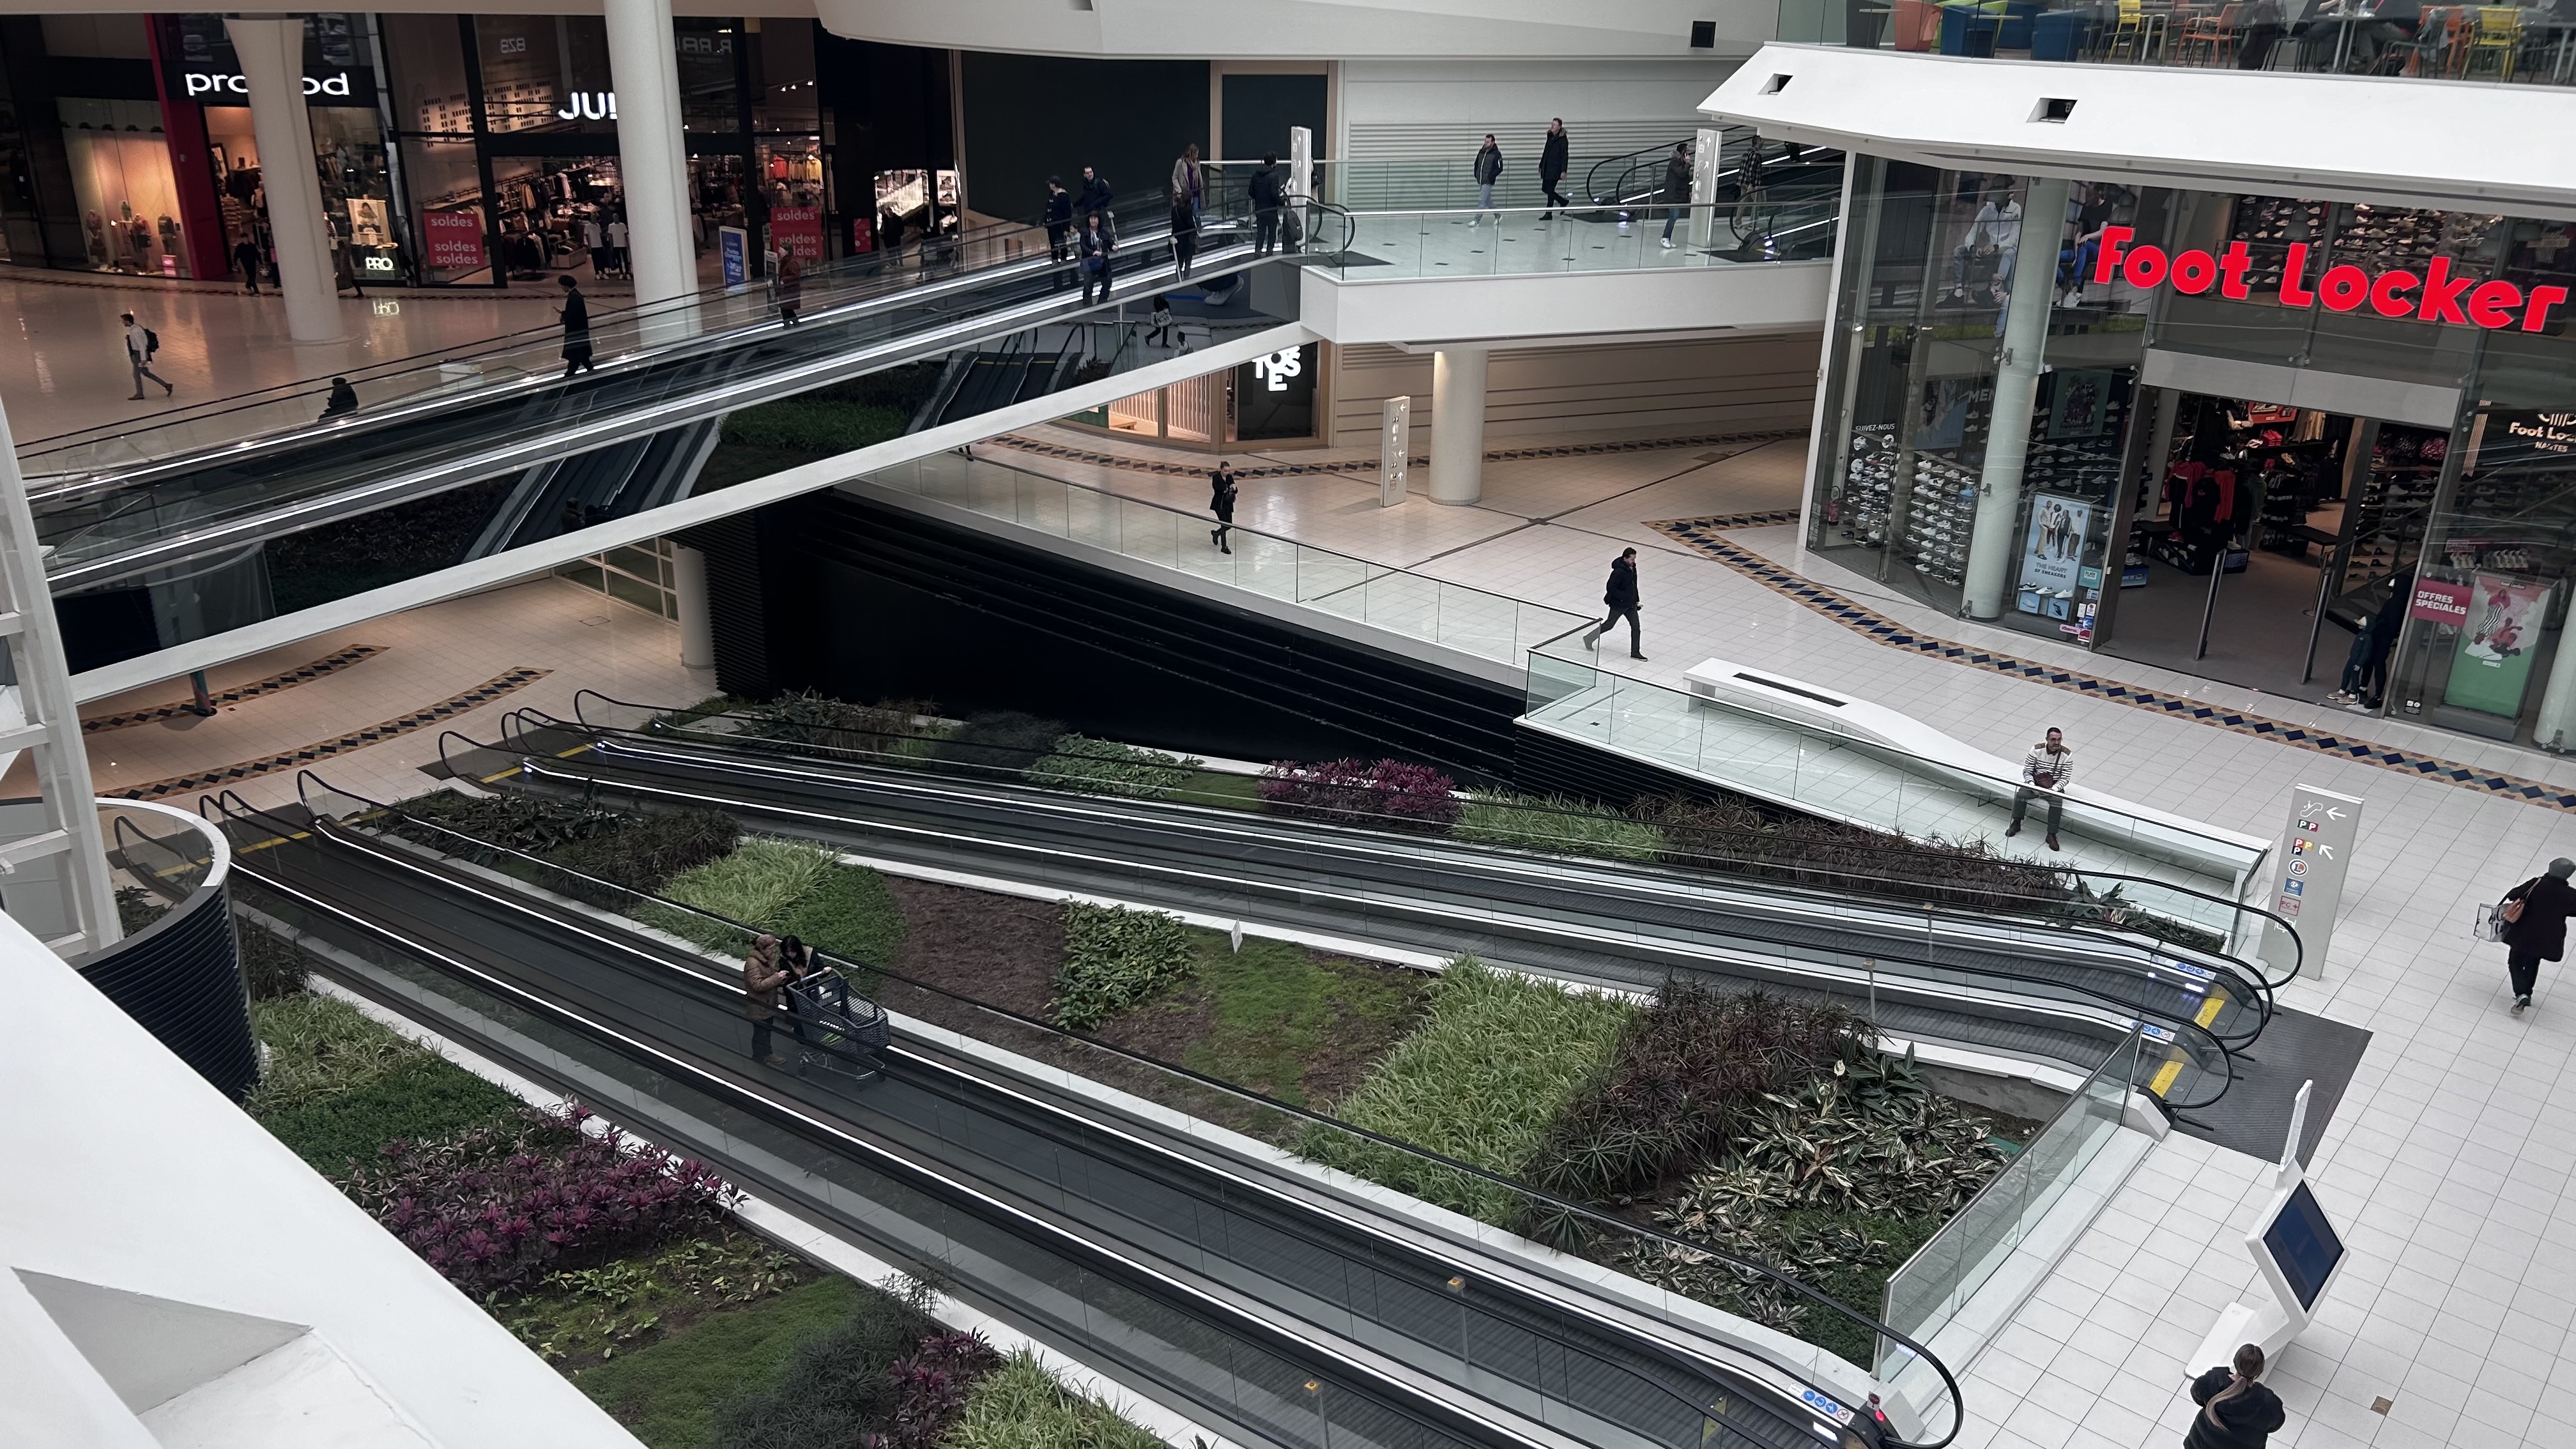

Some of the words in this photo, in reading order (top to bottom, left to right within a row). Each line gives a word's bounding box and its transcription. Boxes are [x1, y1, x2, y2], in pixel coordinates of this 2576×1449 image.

[185, 72, 350, 96] prood
[431, 215, 473, 227] soldes
[777, 210, 815, 221] soldes
[779, 233, 816, 245] soldes
[435, 240, 477, 252] soldes
[365, 257, 394, 271] PRO
[437, 253, 479, 264] soldes
[2094, 226, 2251, 300] Foot
[2279, 242, 2569, 332] Locker
[1855, 423, 1896, 432] SUIVEZ-NOUS
[2509, 422, 2543, 438] Foot
[2041, 569, 2066, 579] SNEAKERS
[2048, 565, 2067, 573] HEART
[2417, 590, 2453, 604] OFFRES
[2415, 598, 2466, 615] SPÉCIALES
